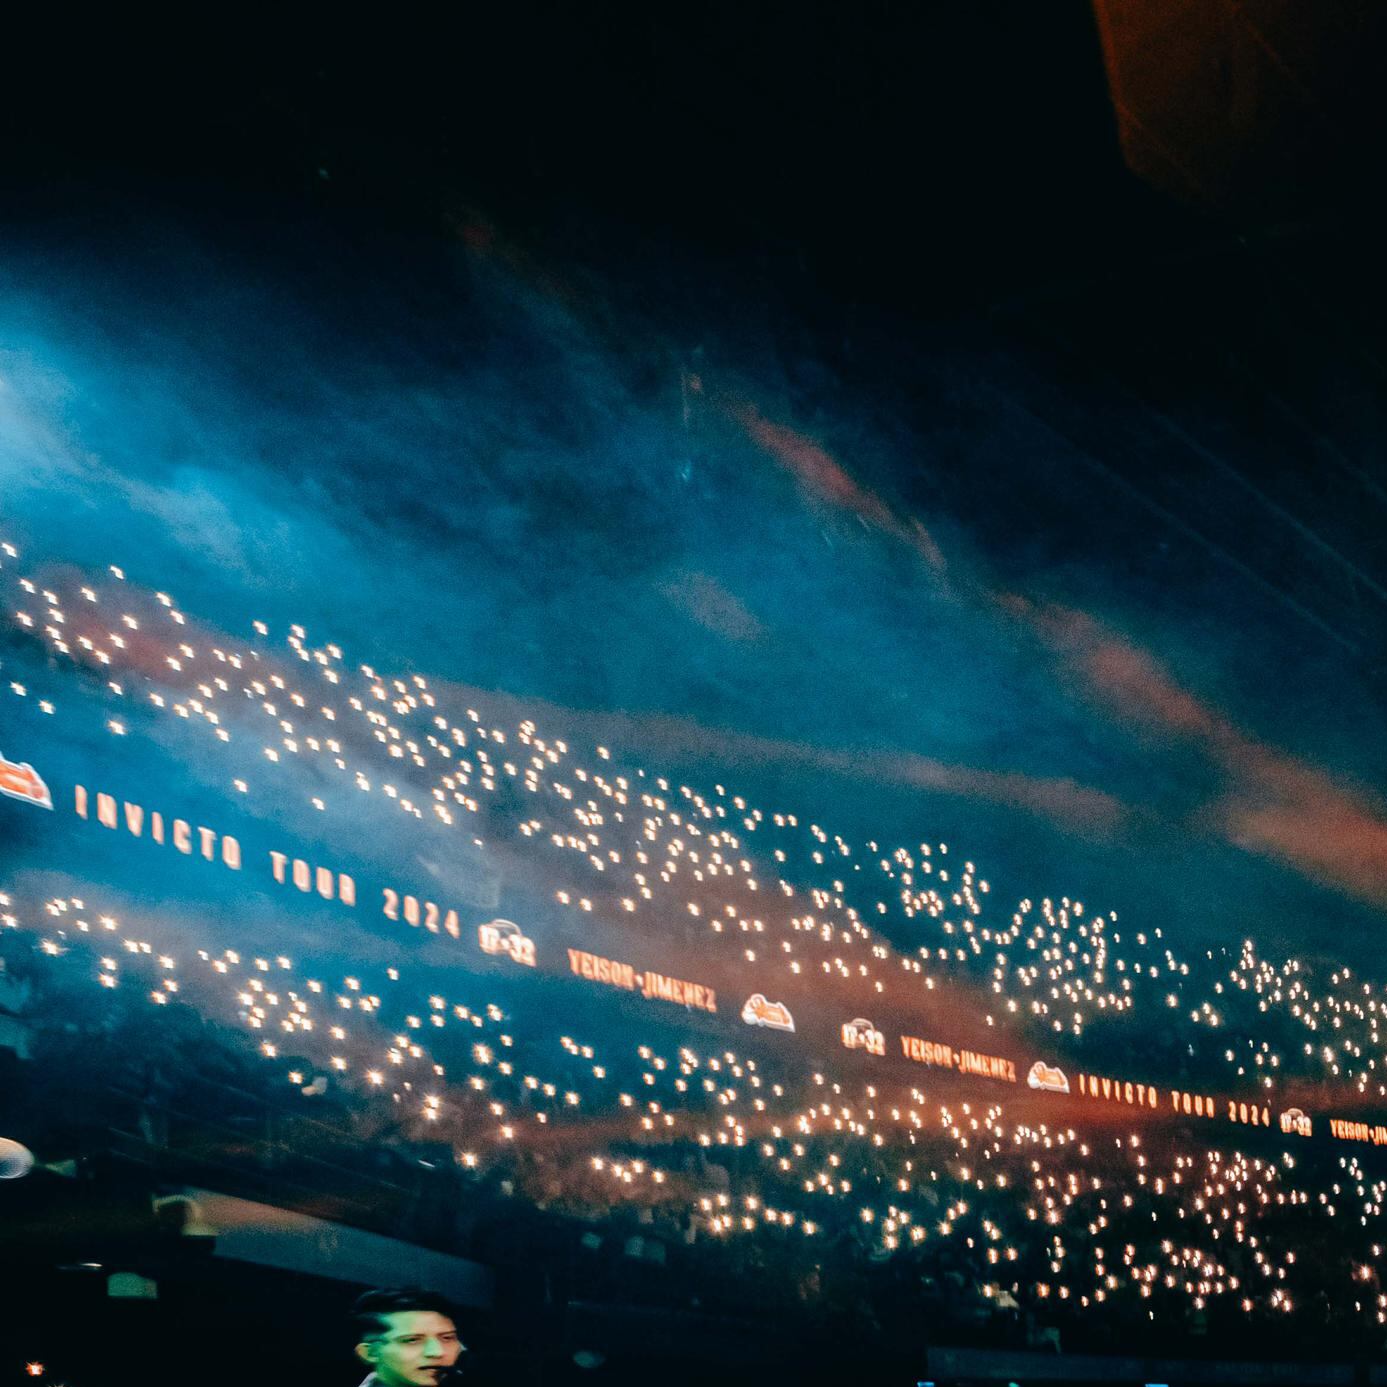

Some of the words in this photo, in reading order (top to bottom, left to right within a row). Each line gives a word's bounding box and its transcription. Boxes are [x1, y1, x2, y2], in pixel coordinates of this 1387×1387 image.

[75, 784, 242, 870] INVICTO
[270, 850, 356, 906] TOUR
[383, 888, 460, 939] 2024
[1080, 1074, 1157, 1108] INVICTO
[1172, 1091, 1215, 1118] TOUR
[1229, 1101, 1270, 1127] 2024
